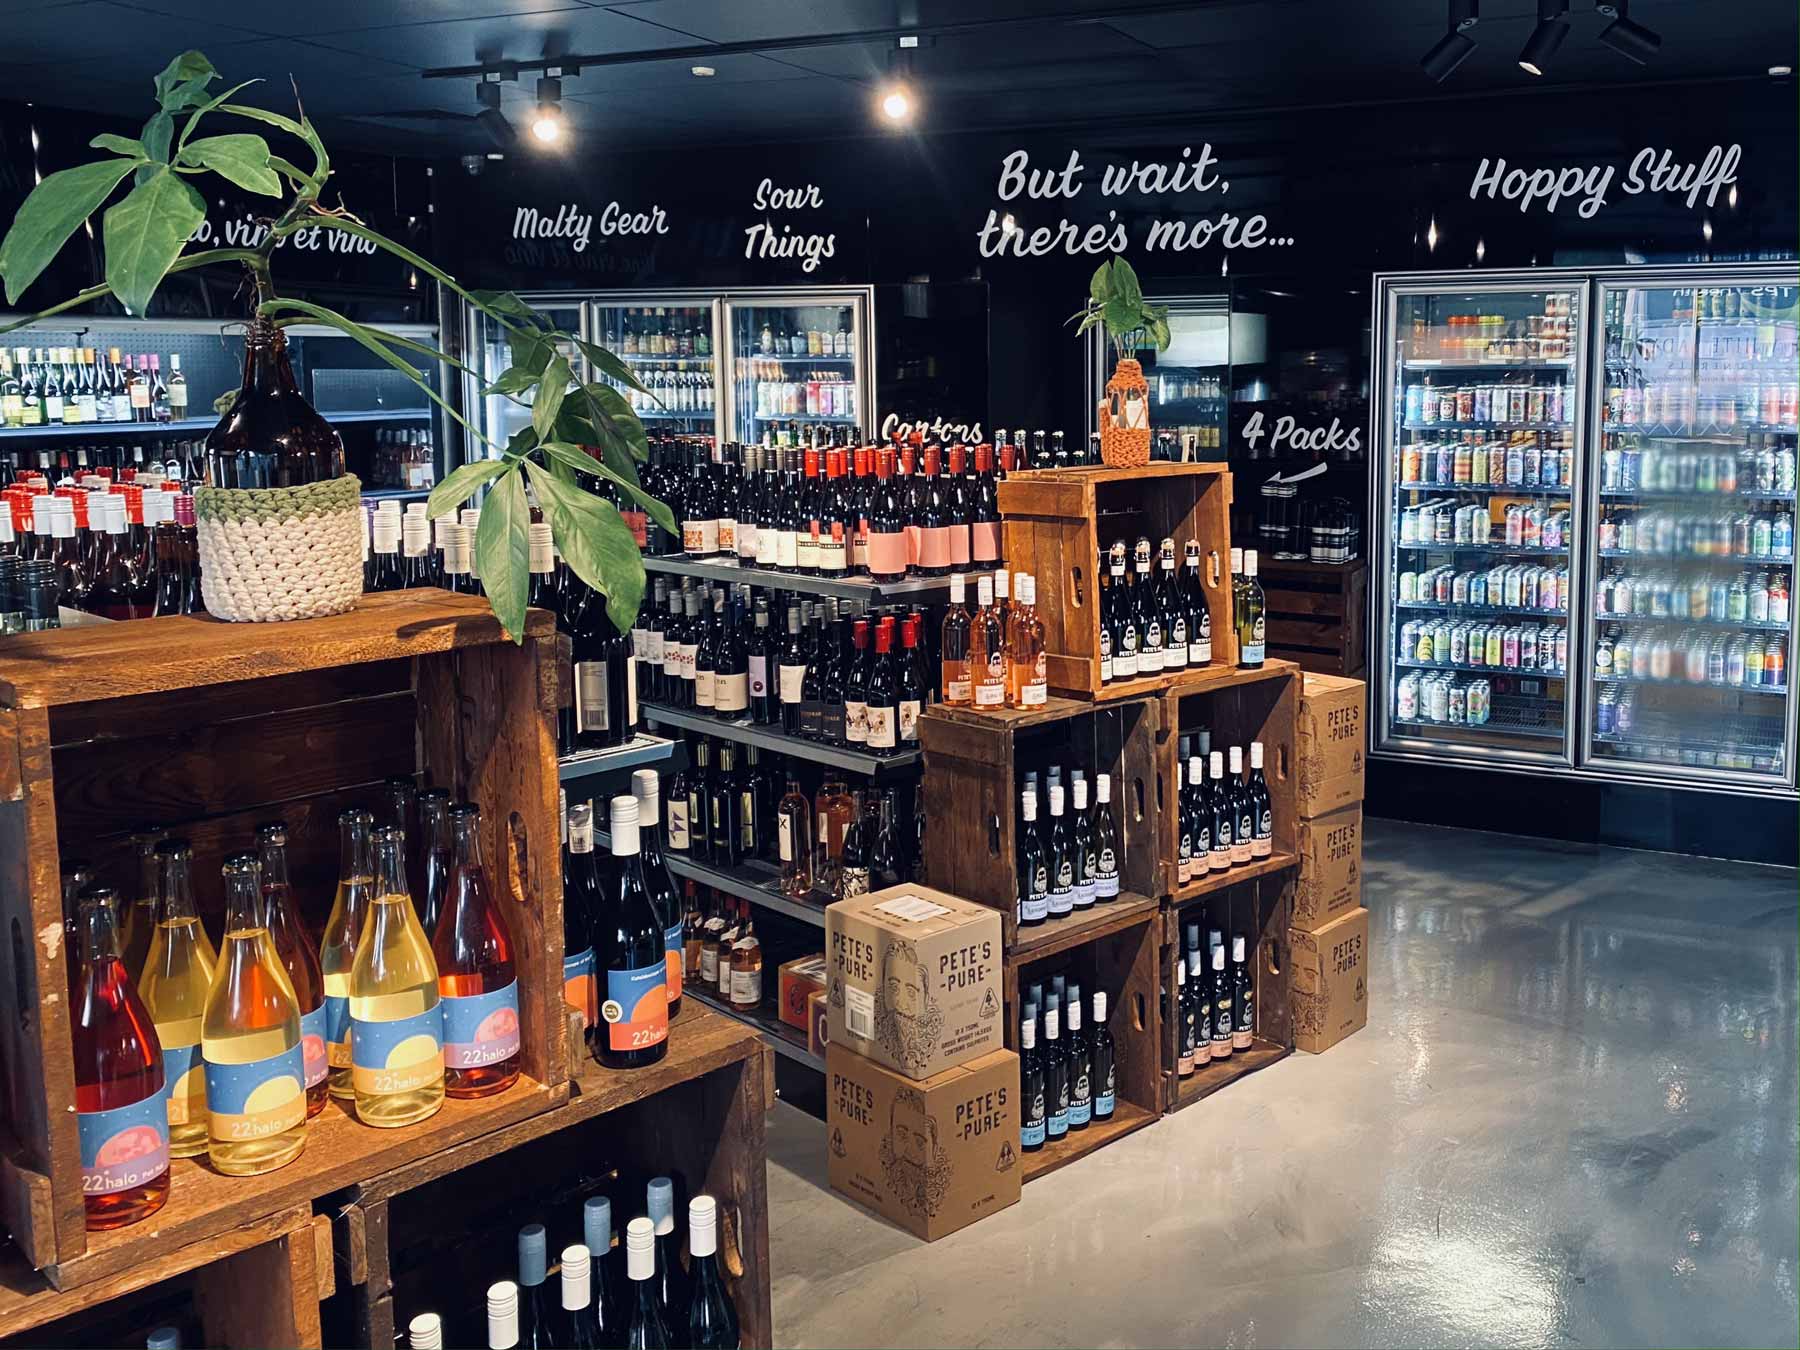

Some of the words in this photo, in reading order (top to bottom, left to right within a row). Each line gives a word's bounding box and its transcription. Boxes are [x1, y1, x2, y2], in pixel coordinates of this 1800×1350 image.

[998, 149, 1085, 201] But
[1100, 142, 1231, 197] wait,
[1469, 157, 1615, 219] Hoppy
[1621, 143, 1743, 209] Stuff
[753, 178, 824, 210] Sour
[293, 225, 321, 251] et
[512, 203, 592, 253] Malty
[599, 201, 669, 236] Gear
[976, 208, 1128, 258] there's
[1145, 212, 1295, 251] more...
[744, 219, 836, 273] Things
[1241, 410, 1266, 450] 4
[1270, 415, 1361, 452] Packs
[1328, 705, 1359, 727] PETE'S
[1327, 823, 1355, 848] PETE'S
[833, 931, 873, 963] PETE'S
[940, 941, 991, 974] PETE'S
[1333, 934, 1361, 961] PETE'S
[834, 1074, 873, 1109] PETE'S
[956, 1087, 1007, 1124] PETE'S
